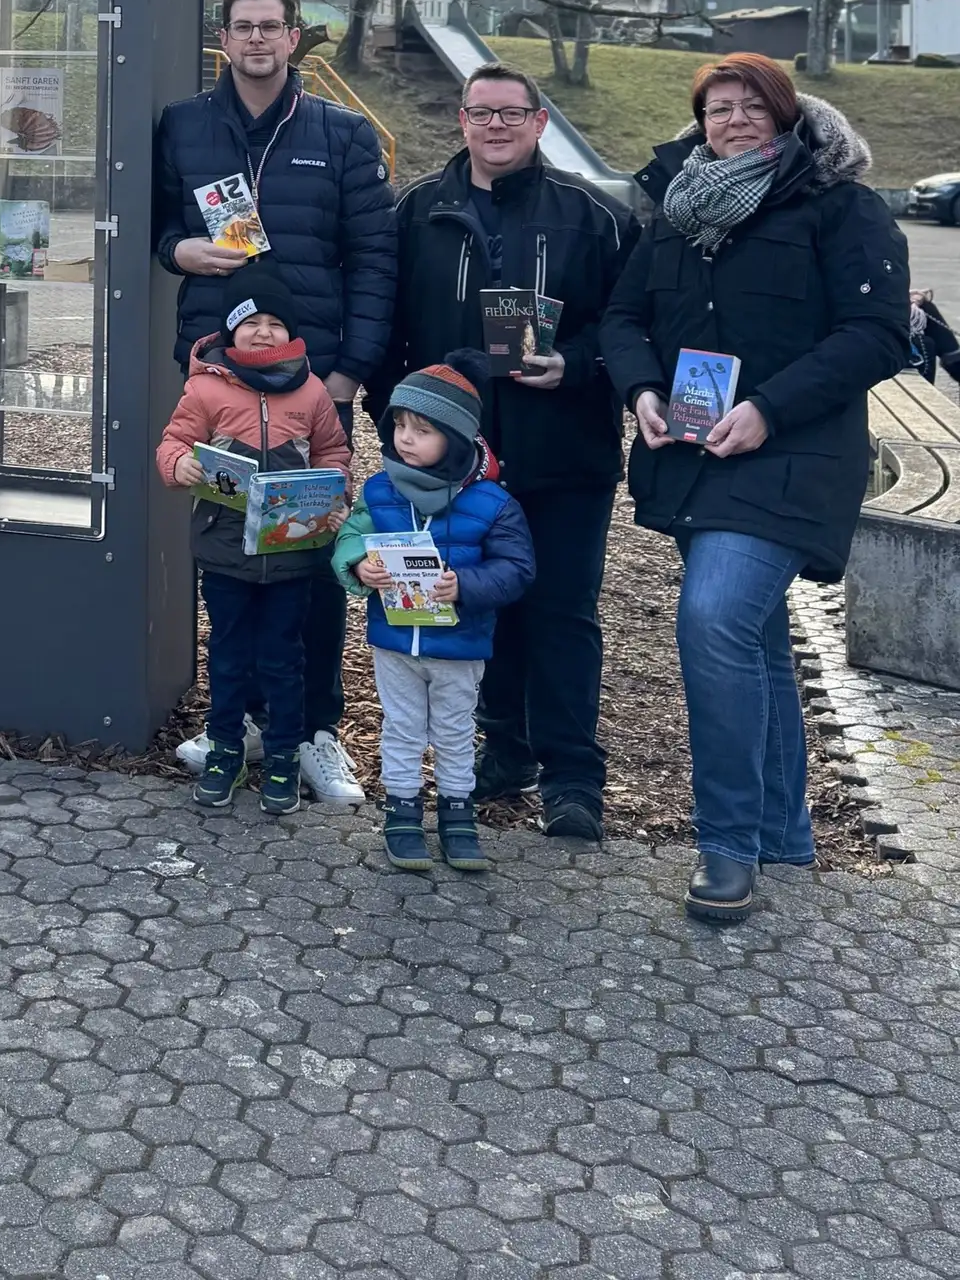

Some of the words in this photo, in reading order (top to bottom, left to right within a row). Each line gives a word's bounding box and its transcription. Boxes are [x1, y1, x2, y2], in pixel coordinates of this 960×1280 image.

[5, 76, 31, 84] SANFT
[32, 77, 59, 85] GAREN
[498, 296, 517, 308] JOY
[485, 307, 534, 316] FIELDING
[684, 385, 714, 398] Martha
[683, 394, 713, 407] Grimes
[672, 402, 687, 413] Die
[689, 405, 707, 416] Frau
